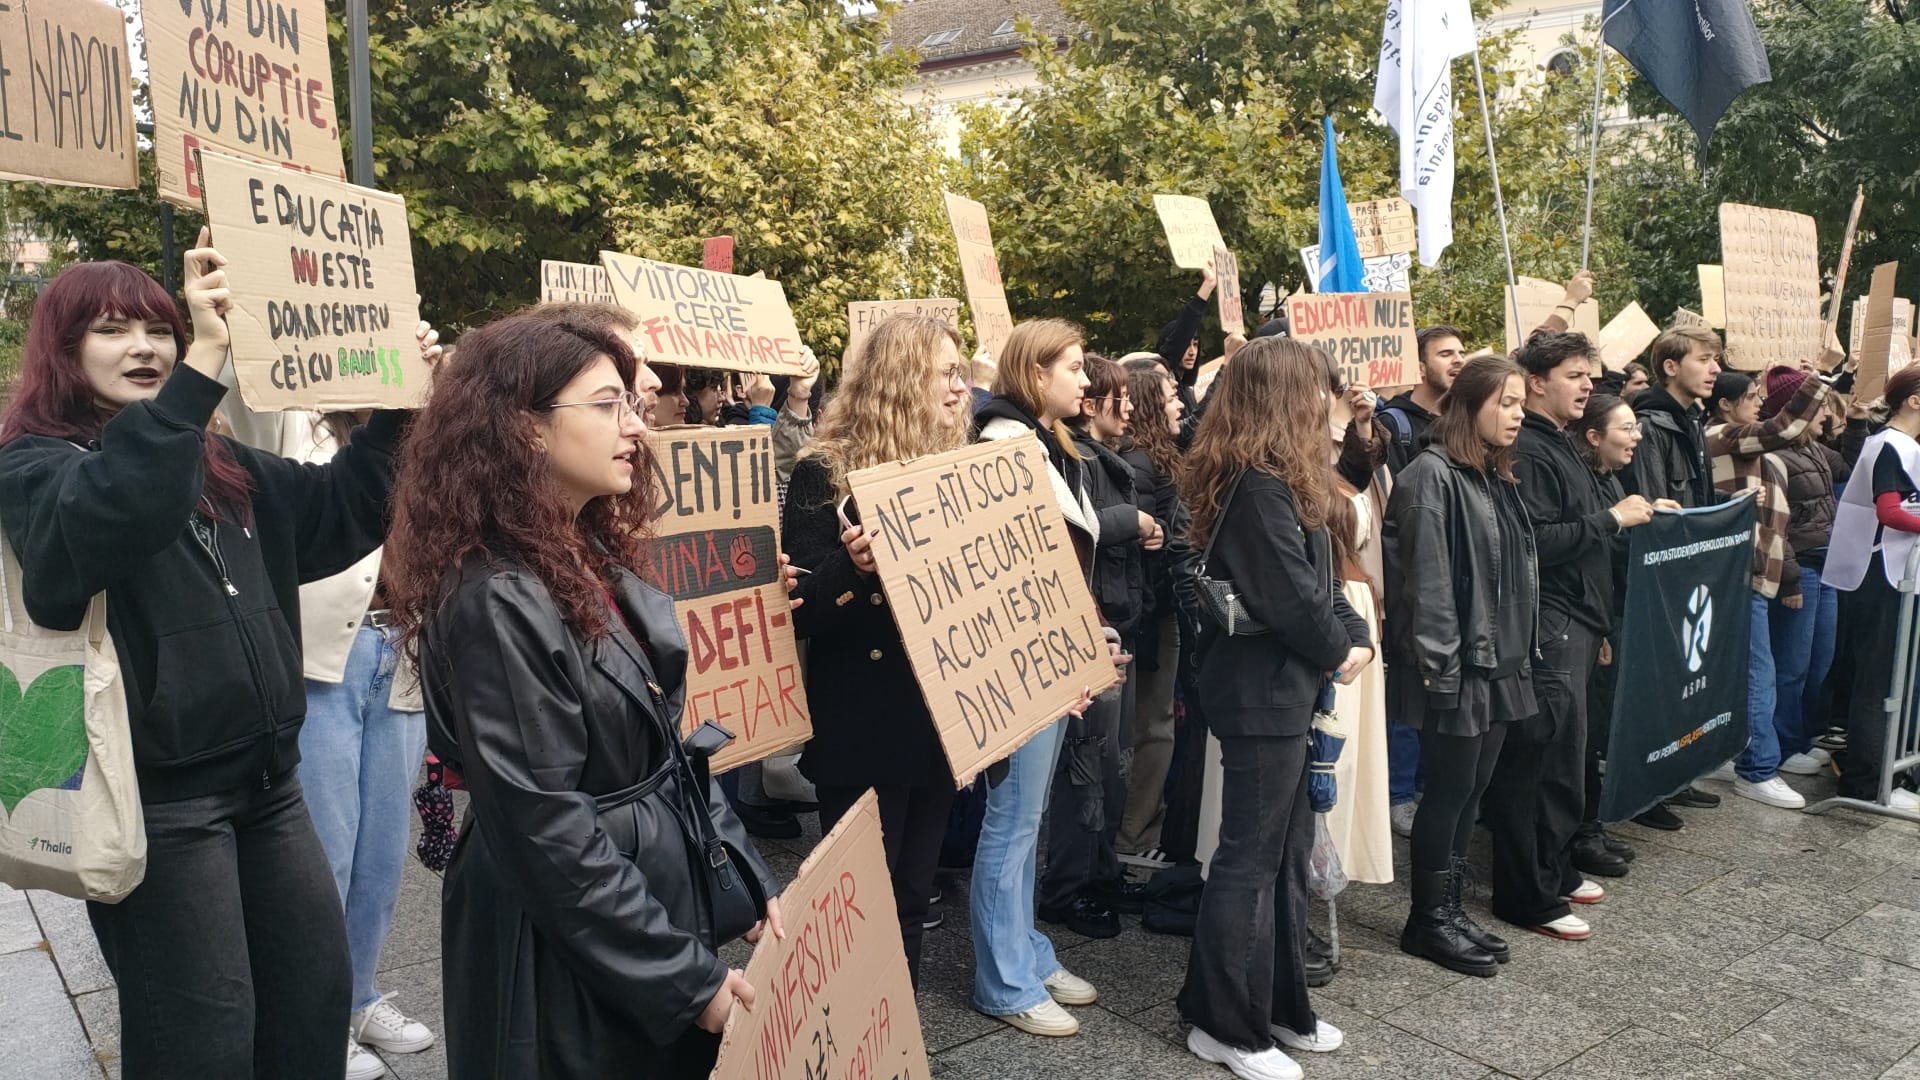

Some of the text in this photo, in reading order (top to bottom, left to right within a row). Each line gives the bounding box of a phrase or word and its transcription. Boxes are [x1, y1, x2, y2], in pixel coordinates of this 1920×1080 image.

[247, 0, 299, 55] DIN
[180, 71, 293, 160] NU DIN
[249, 177, 384, 258] EDUCAȚIA
[1387, 200, 1400, 213] DE
[322, 251, 374, 289] ESTE
[611, 259, 753, 305] VIITORUL
[320, 302, 390, 337] PENTRU
[674, 301, 748, 332] CERE
[1292, 295, 1368, 335] EDUCAȚIA
[642, 315, 801, 367] FINANȚARE
[1341, 335, 1402, 364] PENTRU
[1368, 357, 1403, 386] BANI
[906, 504, 1058, 624] DIN ECUAȚIE
[687, 588, 787, 675] DEFI-
[932, 606, 1003, 681] ACUM
[954, 614, 1097, 750] DIN PEISAJ
[1682, 675, 1707, 700] ASPR
[40, 839, 72, 855] Thalia
